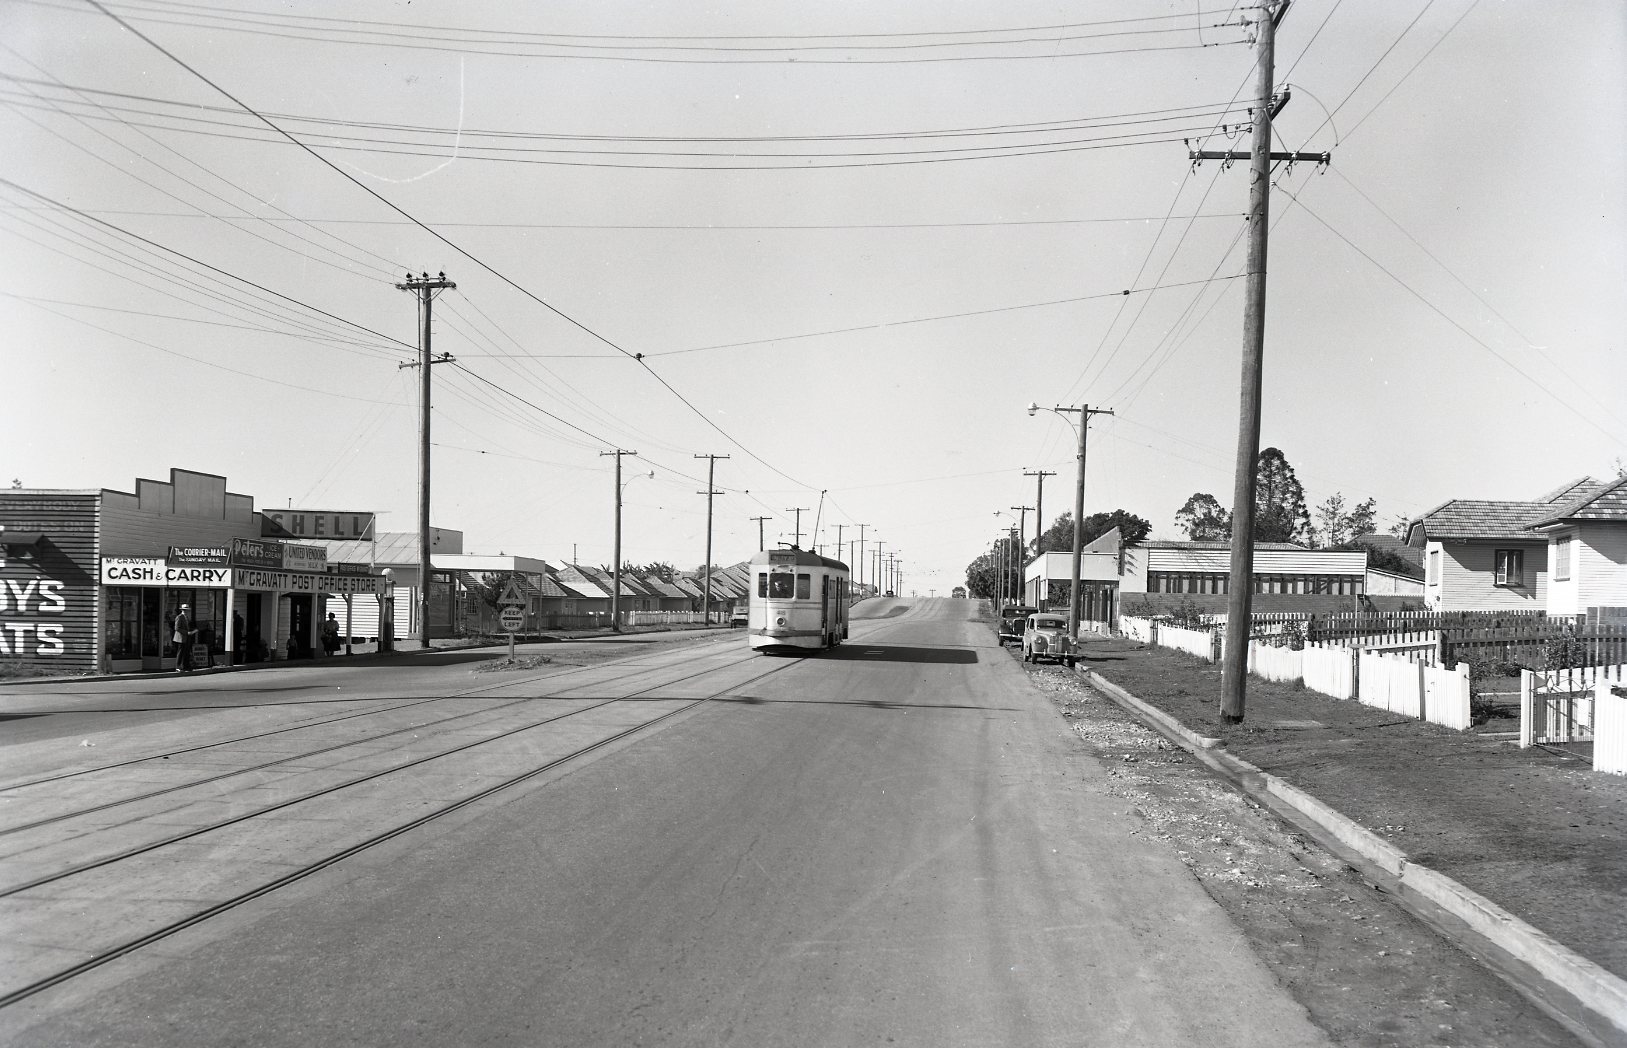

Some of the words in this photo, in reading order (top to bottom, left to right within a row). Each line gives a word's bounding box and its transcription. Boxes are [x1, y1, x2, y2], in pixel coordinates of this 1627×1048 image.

[270, 513, 364, 536] SHELL
[174, 547, 183, 556] The
[184, 548, 227, 557] COURIER-MAIL
[234, 539, 264, 557] Peters
[288, 545, 305, 559] UNITED
[116, 558, 158, 566] GRAVATT
[107, 567, 154, 580] CASH
[155, 572, 163, 581] &
[165, 568, 228, 582] CARRY
[249, 570, 288, 589] GRAVATT
[292, 574, 315, 590] POST
[318, 576, 348, 591] OFFICE
[351, 578, 376, 592] STORE
